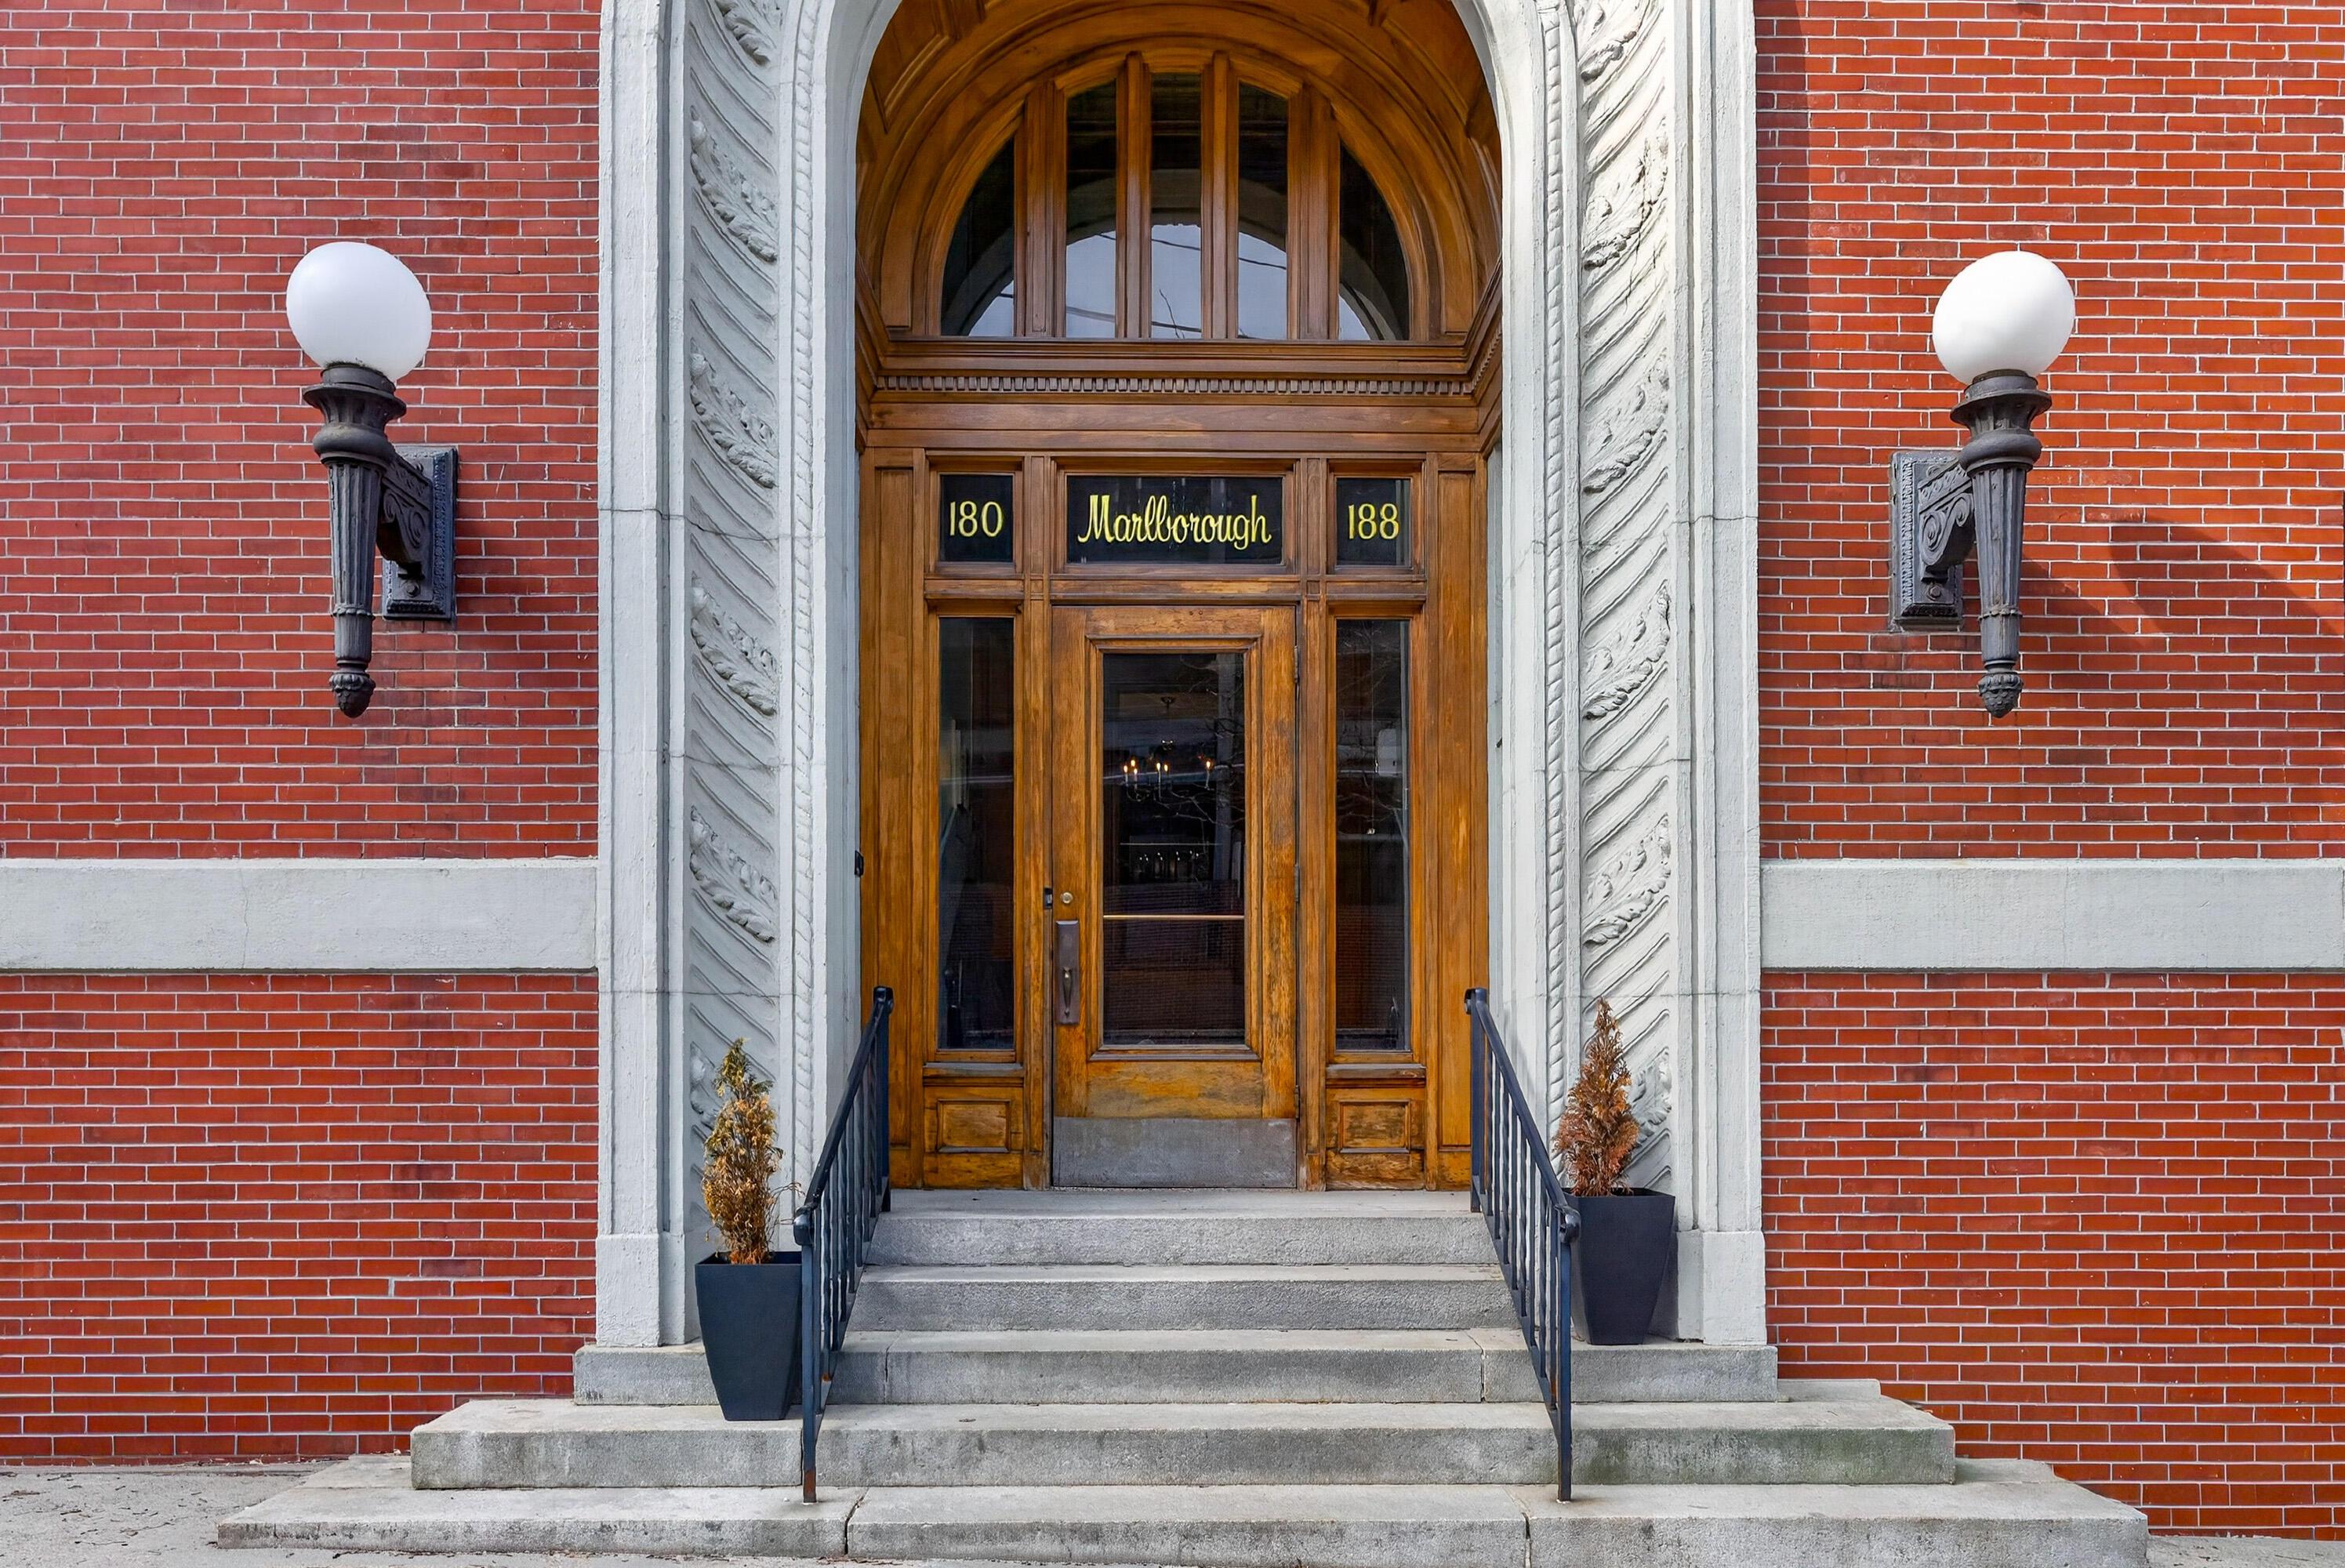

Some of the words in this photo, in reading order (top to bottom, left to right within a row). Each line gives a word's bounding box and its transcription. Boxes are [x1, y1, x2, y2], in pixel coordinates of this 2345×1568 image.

[949, 500, 1004, 538] 180
[1077, 494, 1272, 550] Marlborough
[1348, 503, 1399, 540] 188
